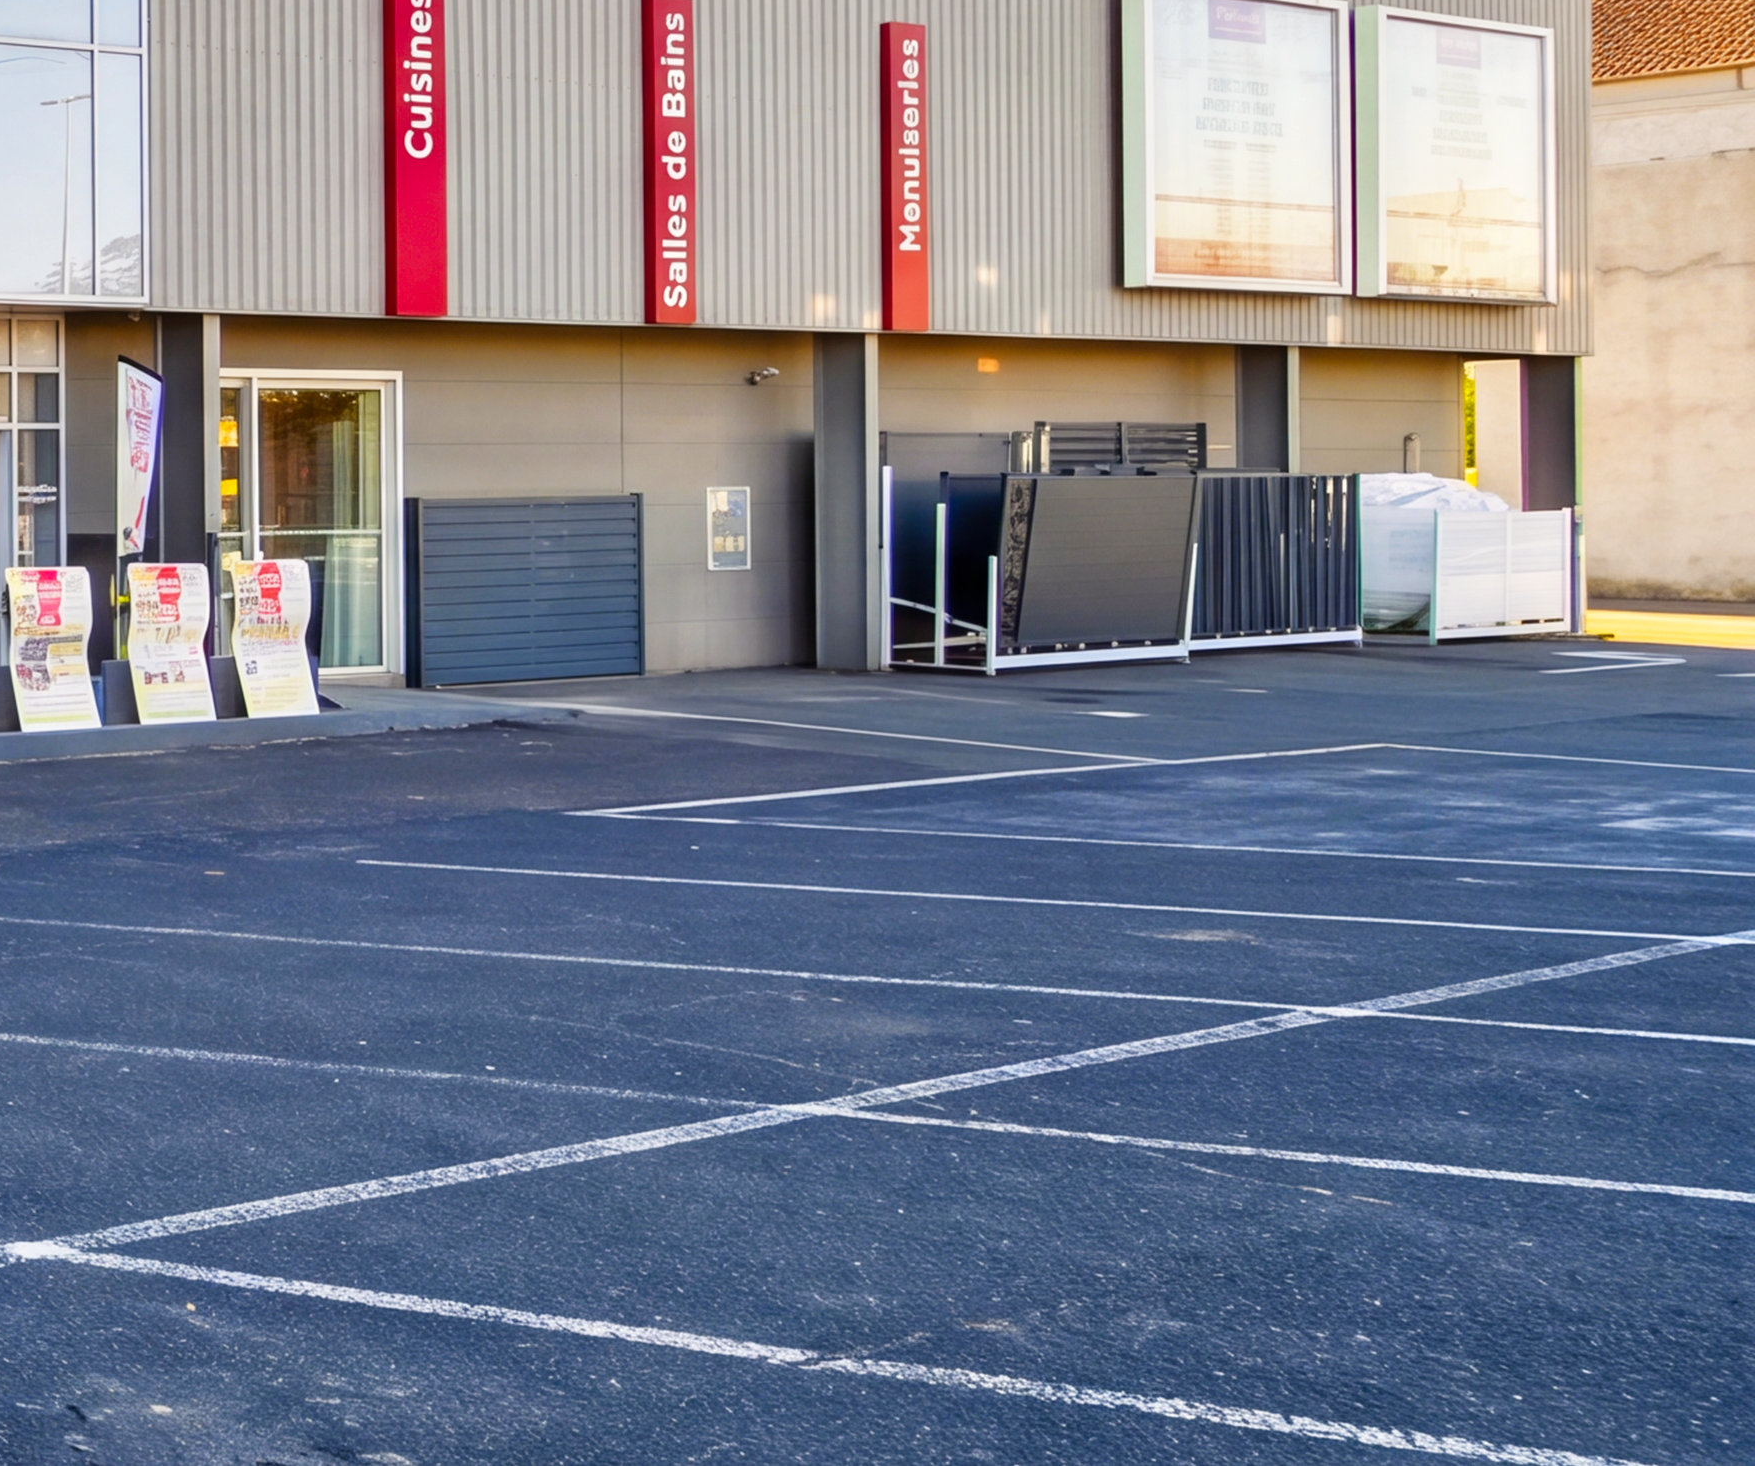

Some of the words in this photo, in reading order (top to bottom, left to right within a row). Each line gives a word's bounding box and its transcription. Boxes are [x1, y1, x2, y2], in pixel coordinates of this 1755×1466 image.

[661, 12, 686, 118] Bains
[661, 131, 687, 180] de
[662, 194, 688, 309] Salles
